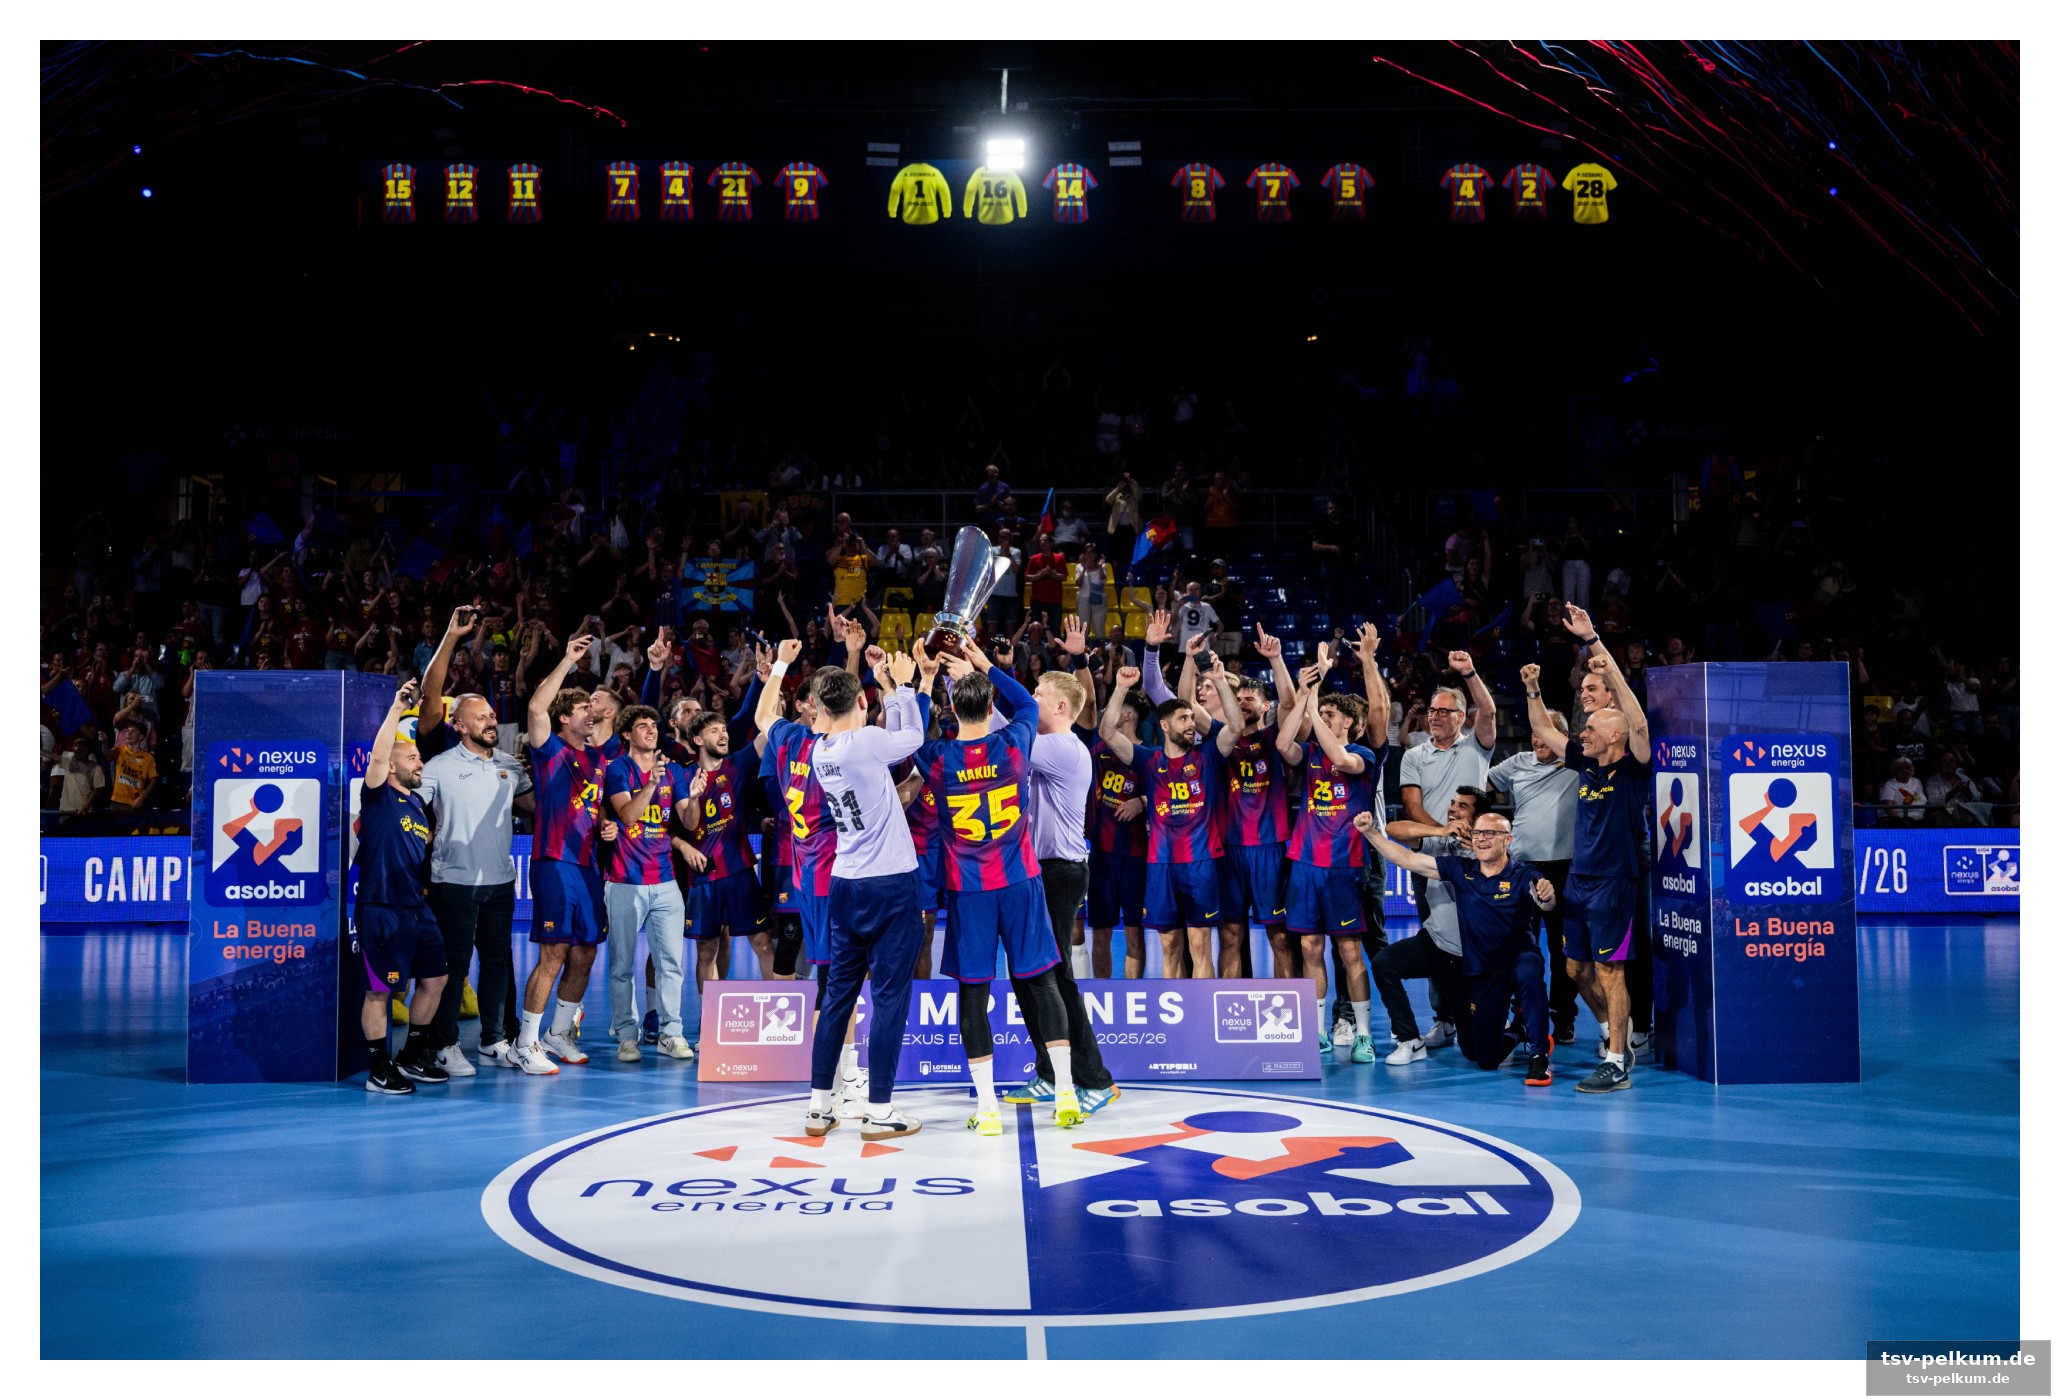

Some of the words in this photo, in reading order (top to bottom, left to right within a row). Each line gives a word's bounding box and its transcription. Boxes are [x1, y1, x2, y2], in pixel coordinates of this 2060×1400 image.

[386, 180, 411, 199] 15
[448, 180, 473, 200] 12
[512, 180, 535, 200] 11
[615, 178, 630, 197] 7
[669, 178, 684, 197] 4
[722, 178, 747, 197] 21
[793, 178, 809, 197] 9
[915, 180, 926, 199] 1
[983, 180, 1008, 199] 16
[1057, 180, 1084, 199] 14
[1191, 179, 1206, 198] 8
[1266, 179, 1280, 198] 7
[1341, 179, 1356, 198] 5
[1459, 180, 1475, 198] 4
[1522, 180, 1537, 199] 2
[1576, 180, 1604, 199] 28
[1187, 609, 1200, 626] 9
[259, 750, 316, 764] nexus
[1671, 745, 1696, 758] nexus
[1771, 744, 1827, 757] nexus
[259, 764, 294, 775] energía
[1771, 758, 1805, 769] energía
[957, 765, 998, 783] MAKUC
[1102, 770, 1125, 793] 88
[1168, 781, 1190, 800] 18
[705, 798, 717, 818] 6
[785, 786, 810, 840] 3
[946, 783, 1021, 841] 35
[1662, 873, 1696, 894] asobal
[1951, 871, 1979, 880] nexus
[225, 880, 305, 900] asobal
[1745, 876, 1822, 896] asobal
[213, 921, 239, 939] La
[247, 920, 316, 939] Buena
[1659, 909, 1670, 926] La
[1671, 911, 1701, 934] Buena
[1735, 918, 1760, 936] La
[1768, 917, 1834, 936] Buena
[222, 941, 305, 964] energía
[1663, 934, 1697, 957] energía
[1745, 938, 1825, 962] energía
[725, 1020, 755, 1028] nexus
[1222, 1018, 1252, 1026] nexus
[766, 1034, 796, 1042] asobal
[1096, 1032, 1167, 1045] 2025/26
[1264, 1032, 1295, 1040] asobal
[579, 1177, 976, 1197] nexus
[651, 1197, 894, 1215] energía
[1086, 1191, 1510, 1217] asobal
